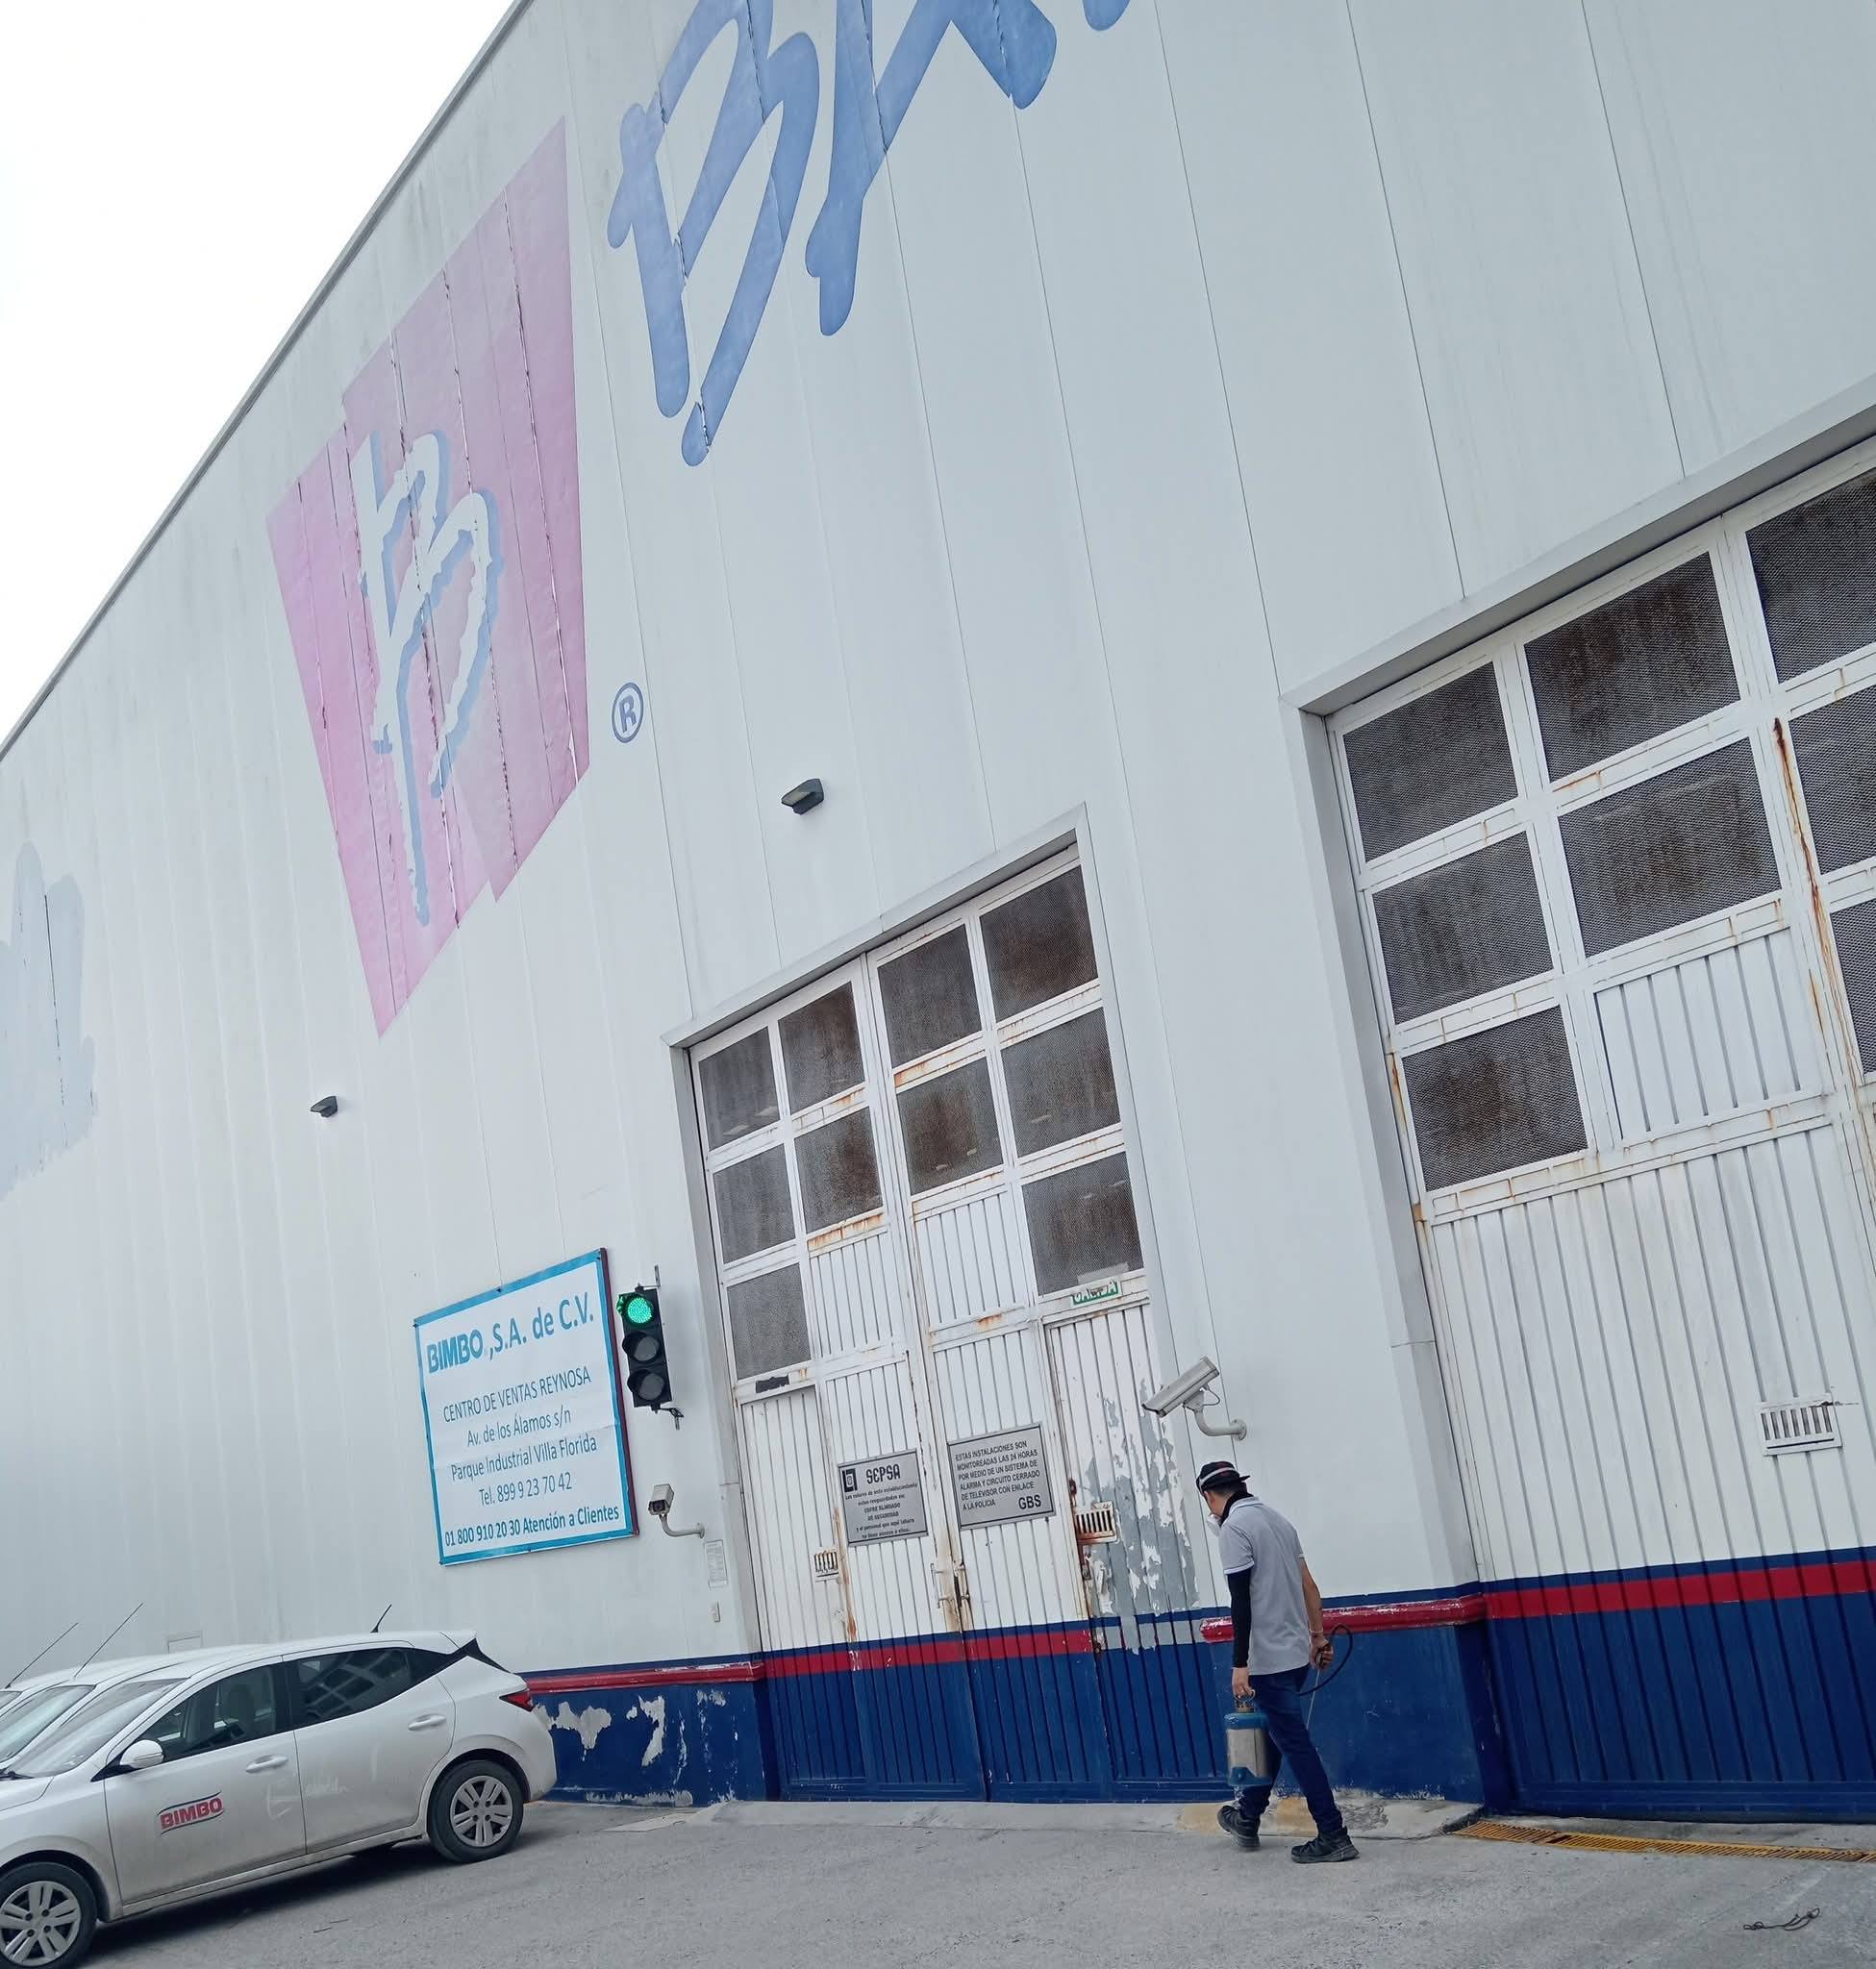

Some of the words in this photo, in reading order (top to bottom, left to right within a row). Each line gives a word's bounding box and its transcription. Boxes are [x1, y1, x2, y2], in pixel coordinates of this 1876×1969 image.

[427, 1329, 483, 1374] BIMBO
[533, 1308, 555, 1339] de
[559, 1292, 593, 1330] C.V.
[443, 1397, 481, 1422] CENTRO
[484, 1393, 496, 1412] DE
[498, 1381, 538, 1408] VENTAS
[538, 1365, 591, 1395] REYNOSA
[467, 1430, 481, 1447] Av.
[483, 1425, 495, 1443] de
[497, 1422, 511, 1440] los
[513, 1412, 551, 1436] Álamos
[554, 1404, 571, 1428] s/n
[451, 1462, 484, 1482] Parque
[486, 1446, 532, 1473] Industrial
[534, 1440, 557, 1462] Villa
[559, 1433, 597, 1458] Florida
[955, 1452, 971, 1461] ESTAS
[972, 1444, 1013, 1458] INSTALACIONES
[1014, 1441, 1027, 1450] SON
[957, 1457, 998, 1471] MONITOREADAS
[998, 1455, 1010, 1463] LAS
[1018, 1449, 1038, 1459] HORAS
[865, 1463, 901, 1484] SEPSA
[958, 1472, 969, 1481] POR
[969, 1469, 987, 1480] MEDIO
[987, 1467, 995, 1476] DE
[1004, 1461, 1029, 1472] SISTEMA
[1029, 1459, 1038, 1468] DE
[960, 1481, 981, 1491] ALARMA
[986, 1475, 1012, 1486] CIRCUITO
[1012, 1470, 1040, 1481] CERRADO
[479, 1486, 495, 1507] Tel.
[497, 1483, 515, 1503] 899
[518, 1481, 524, 1499] 9
[527, 1478, 539, 1497] 23
[542, 1475, 556, 1495] 70
[558, 1472, 572, 1491] 42
[998, 1485, 1011, 1494] CON
[1011, 1482, 1035, 1492] ENLACE
[1018, 1494, 1041, 1509] GBS
[444, 1531, 456, 1547] 01
[457, 1527, 474, 1545] 800
[476, 1523, 494, 1543] 910
[496, 1521, 508, 1539] 20
[510, 1519, 520, 1535] 30
[522, 1510, 566, 1534] Atención
[568, 1515, 575, 1527] a
[577, 1505, 619, 1526] Clientes
[160, 1797, 222, 1830] BIMBO
